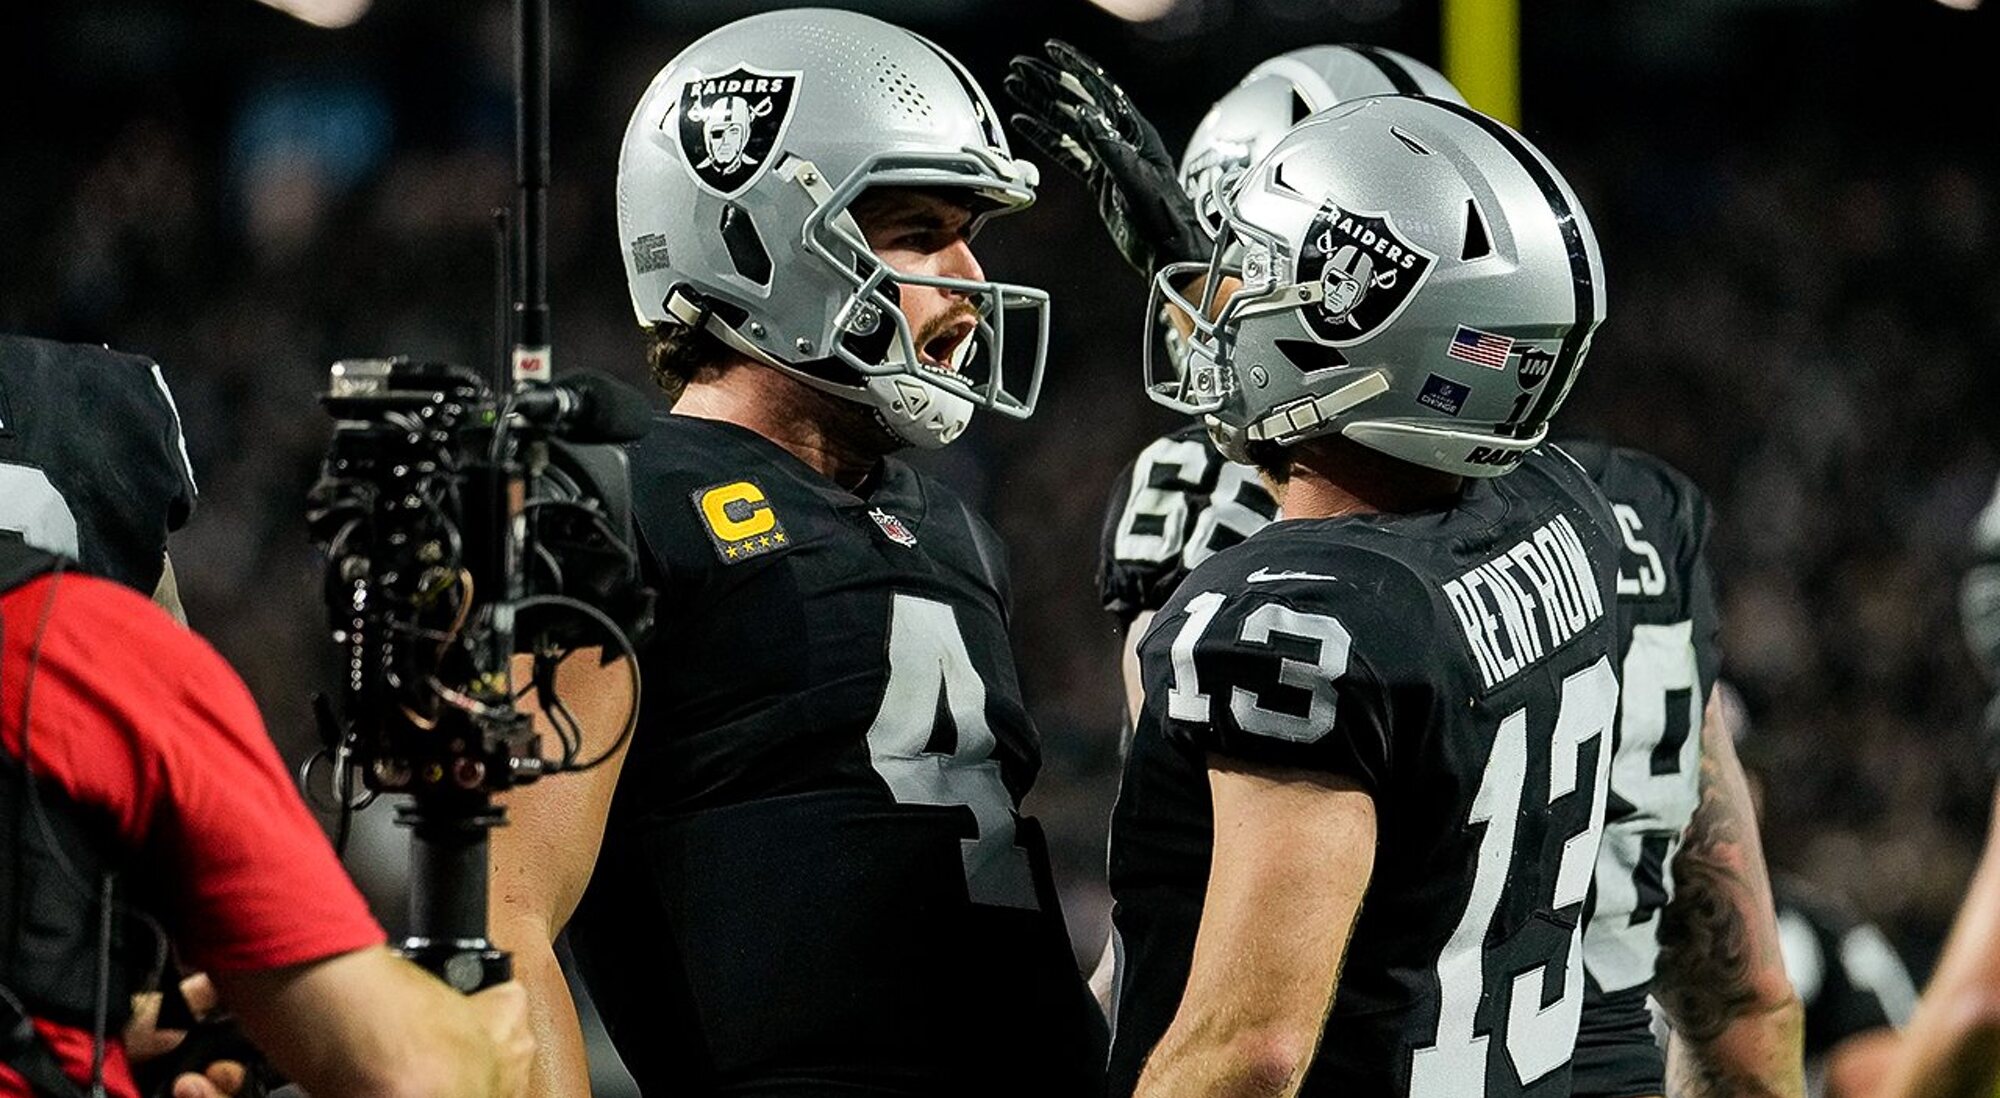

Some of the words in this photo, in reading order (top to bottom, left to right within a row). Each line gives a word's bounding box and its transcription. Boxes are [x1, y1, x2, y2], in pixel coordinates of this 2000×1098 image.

[690, 78, 783, 98] RAIDERS
[1325, 204, 1417, 270] RAIDERS
[1519, 358, 1549, 376] JM
[701, 481, 776, 542] C
[1442, 514, 1604, 689] RENFROW
[1168, 590, 1353, 744] 13
[866, 593, 1042, 911] 4
[1408, 655, 1620, 1098] 13
